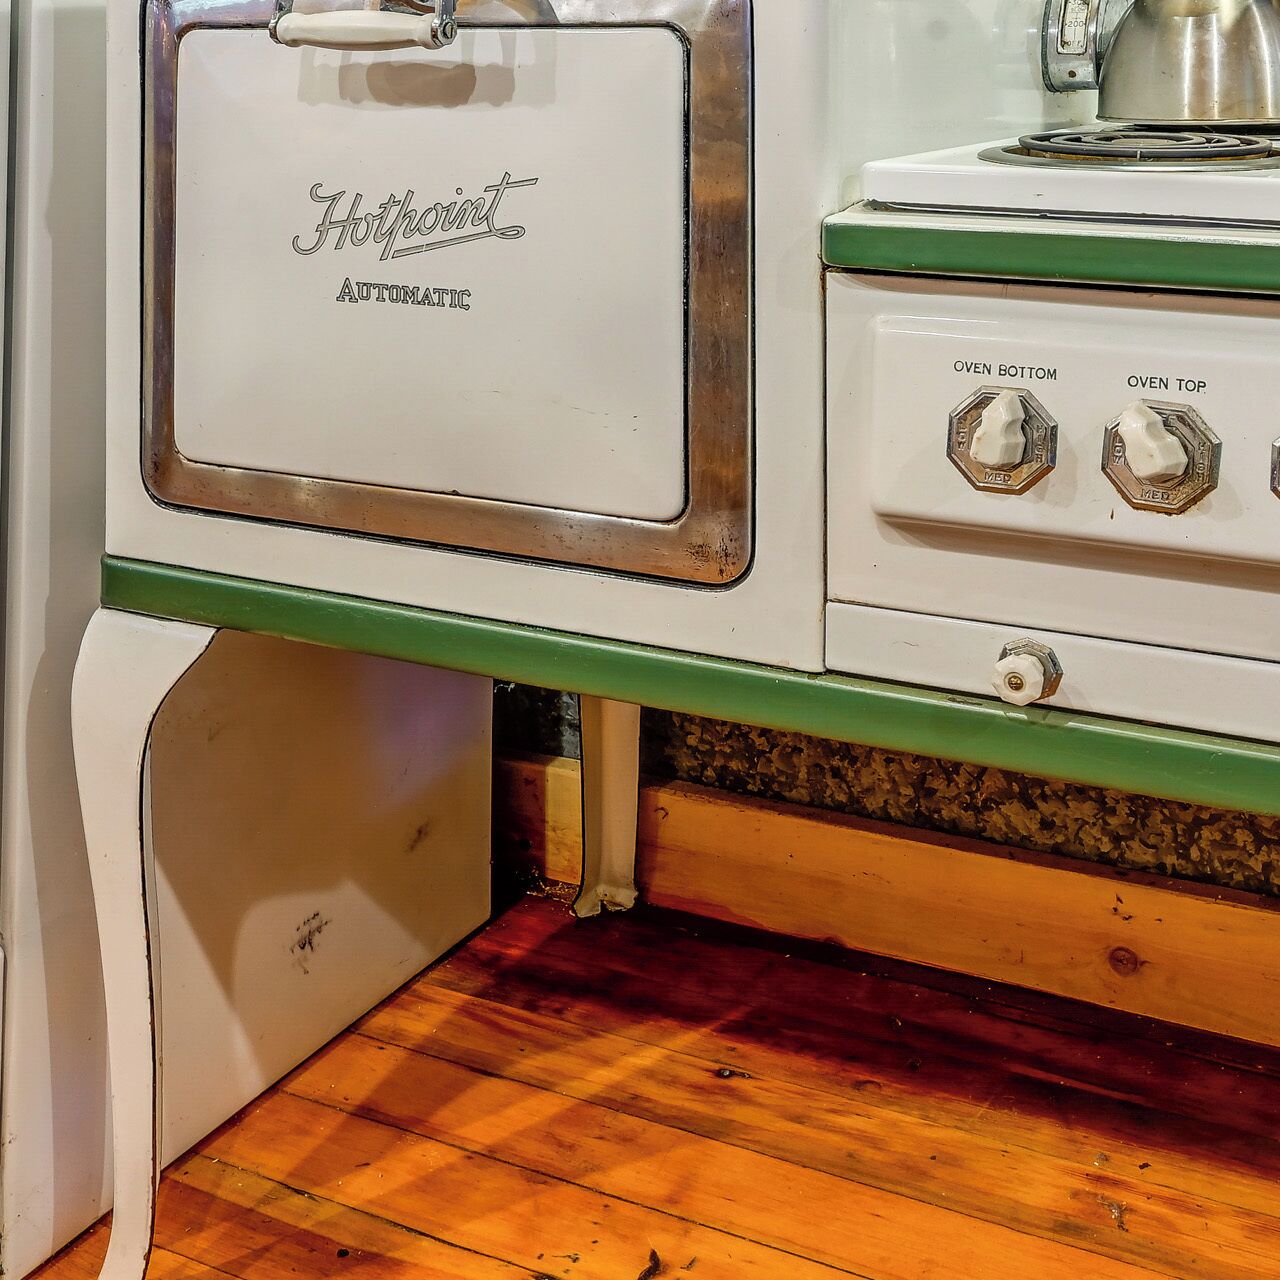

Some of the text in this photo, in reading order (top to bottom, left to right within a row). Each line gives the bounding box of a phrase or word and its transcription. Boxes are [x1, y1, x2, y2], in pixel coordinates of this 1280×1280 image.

[292, 171, 539, 261] Hotpoint
[336, 277, 472, 311] AUTOMATIC
[953, 360, 1057, 381] OVEN BOTTOM
[1127, 375, 1207, 393] OVEN TOP
[984, 471, 1013, 483] MED
[1140, 487, 1171, 501] MED
